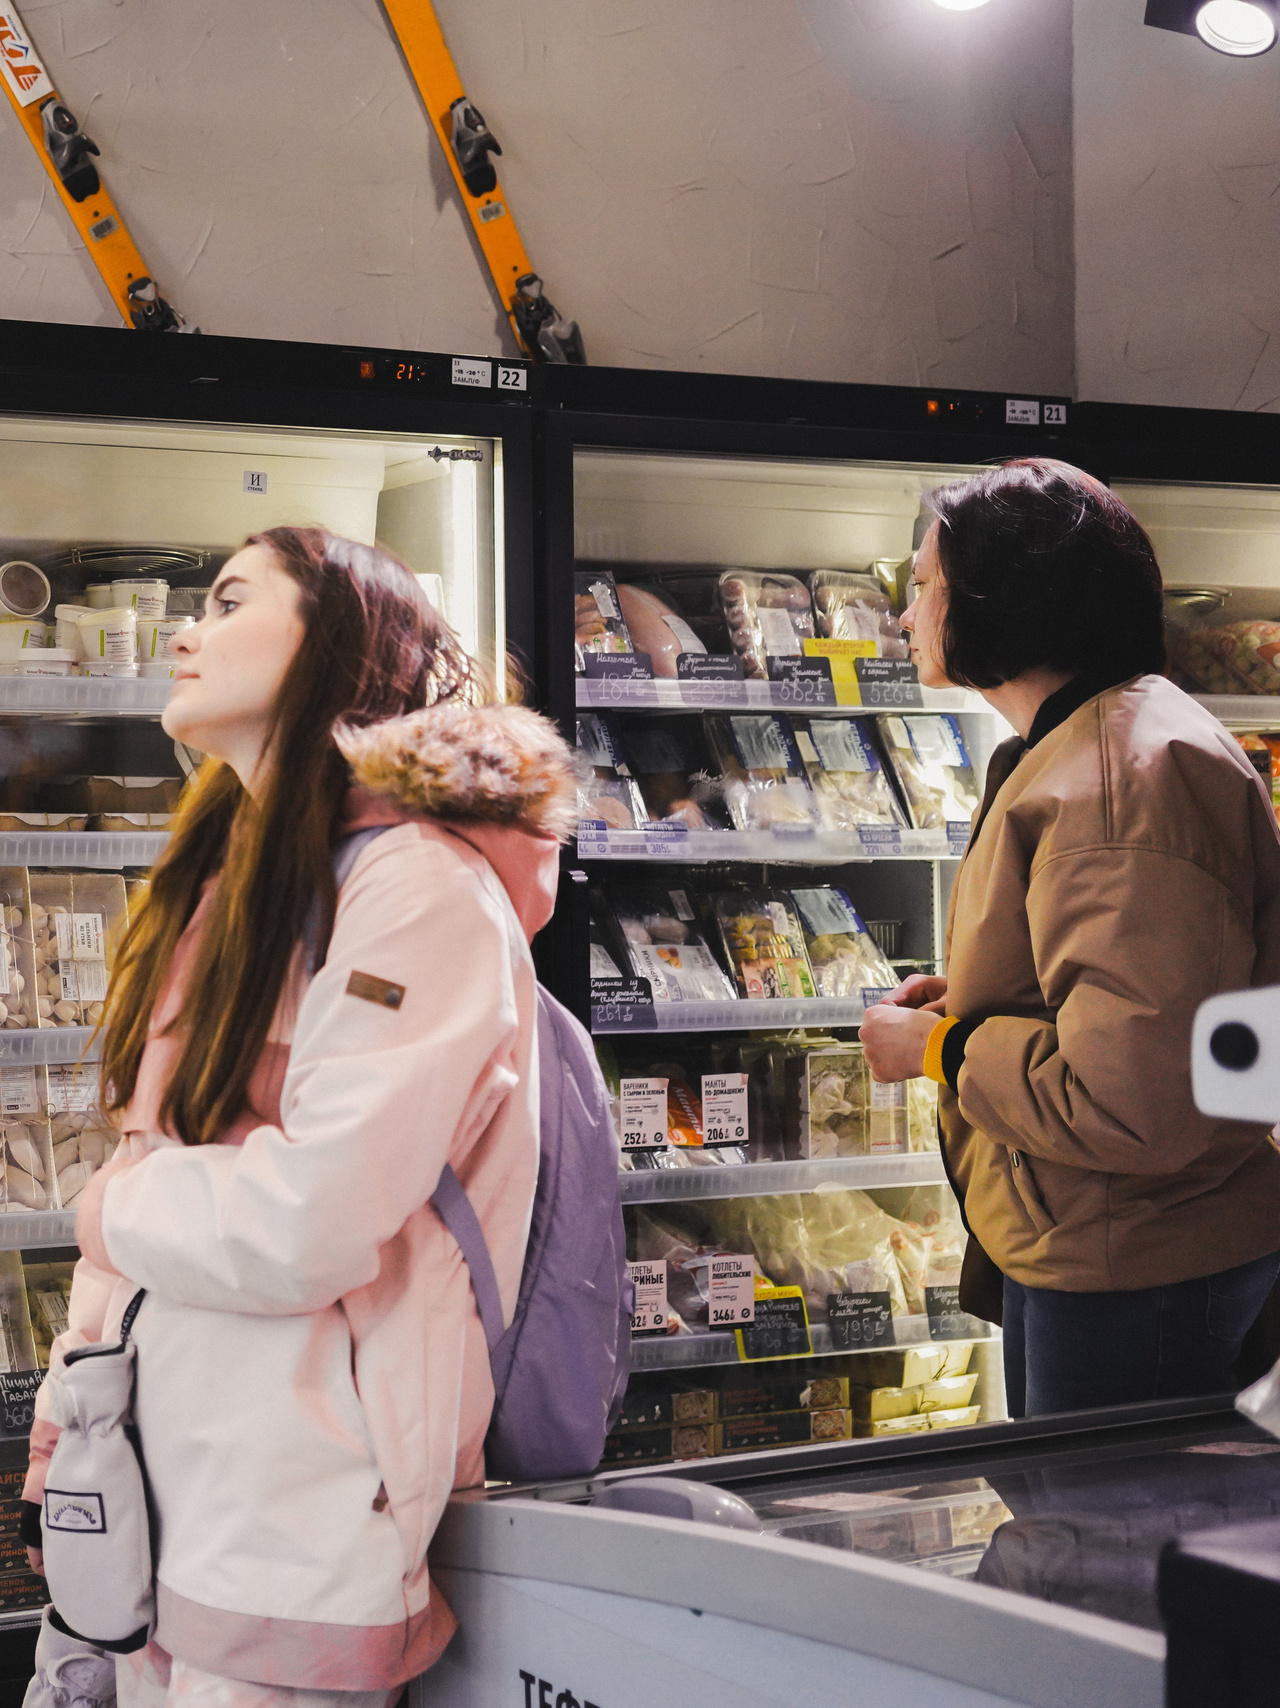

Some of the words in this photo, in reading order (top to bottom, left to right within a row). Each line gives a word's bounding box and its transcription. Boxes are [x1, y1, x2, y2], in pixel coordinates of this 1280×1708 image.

[397, 363, 413, 380] 21
[501, 370, 521, 387] 22
[1046, 406, 1062, 422] 21
[597, 672, 632, 701] 187
[651, 843, 667, 854] 305
[623, 1082, 649, 1090] ВАРЕНИКИ
[704, 1079, 727, 1089] МАНТЫ
[704, 1087, 745, 1096] ПО-ДОМАШНЕМУ
[624, 1132, 642, 1146] 252
[707, 1127, 724, 1141] 206
[712, 1261, 743, 1272] КОТЛЕТЫ
[711, 1270, 752, 1280] ЛЮБИТЕЛЬСКИЕ
[712, 1308, 730, 1322] 346
